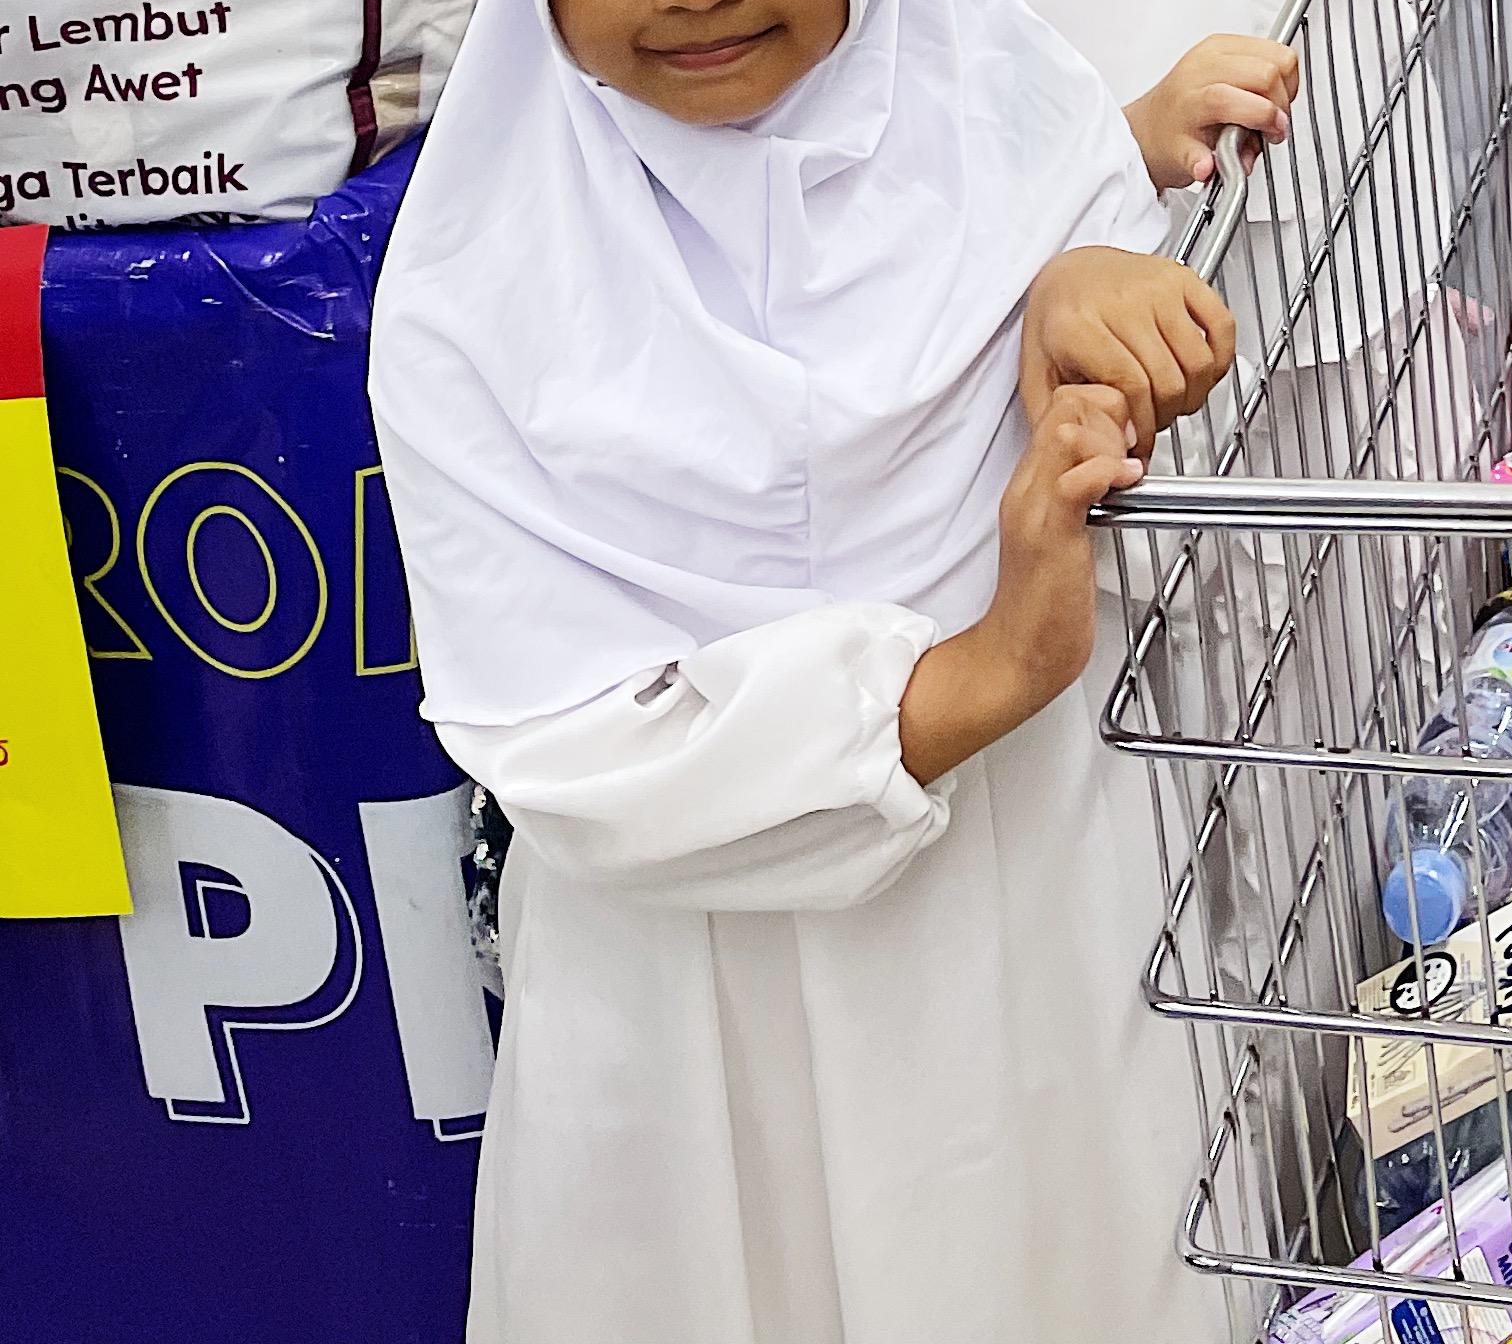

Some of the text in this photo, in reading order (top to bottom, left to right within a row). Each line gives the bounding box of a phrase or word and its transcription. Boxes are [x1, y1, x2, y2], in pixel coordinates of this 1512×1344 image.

[28, 1, 232, 53] Lembut
[84, 62, 204, 103] Awet
[63, 151, 249, 199] Terbaik
